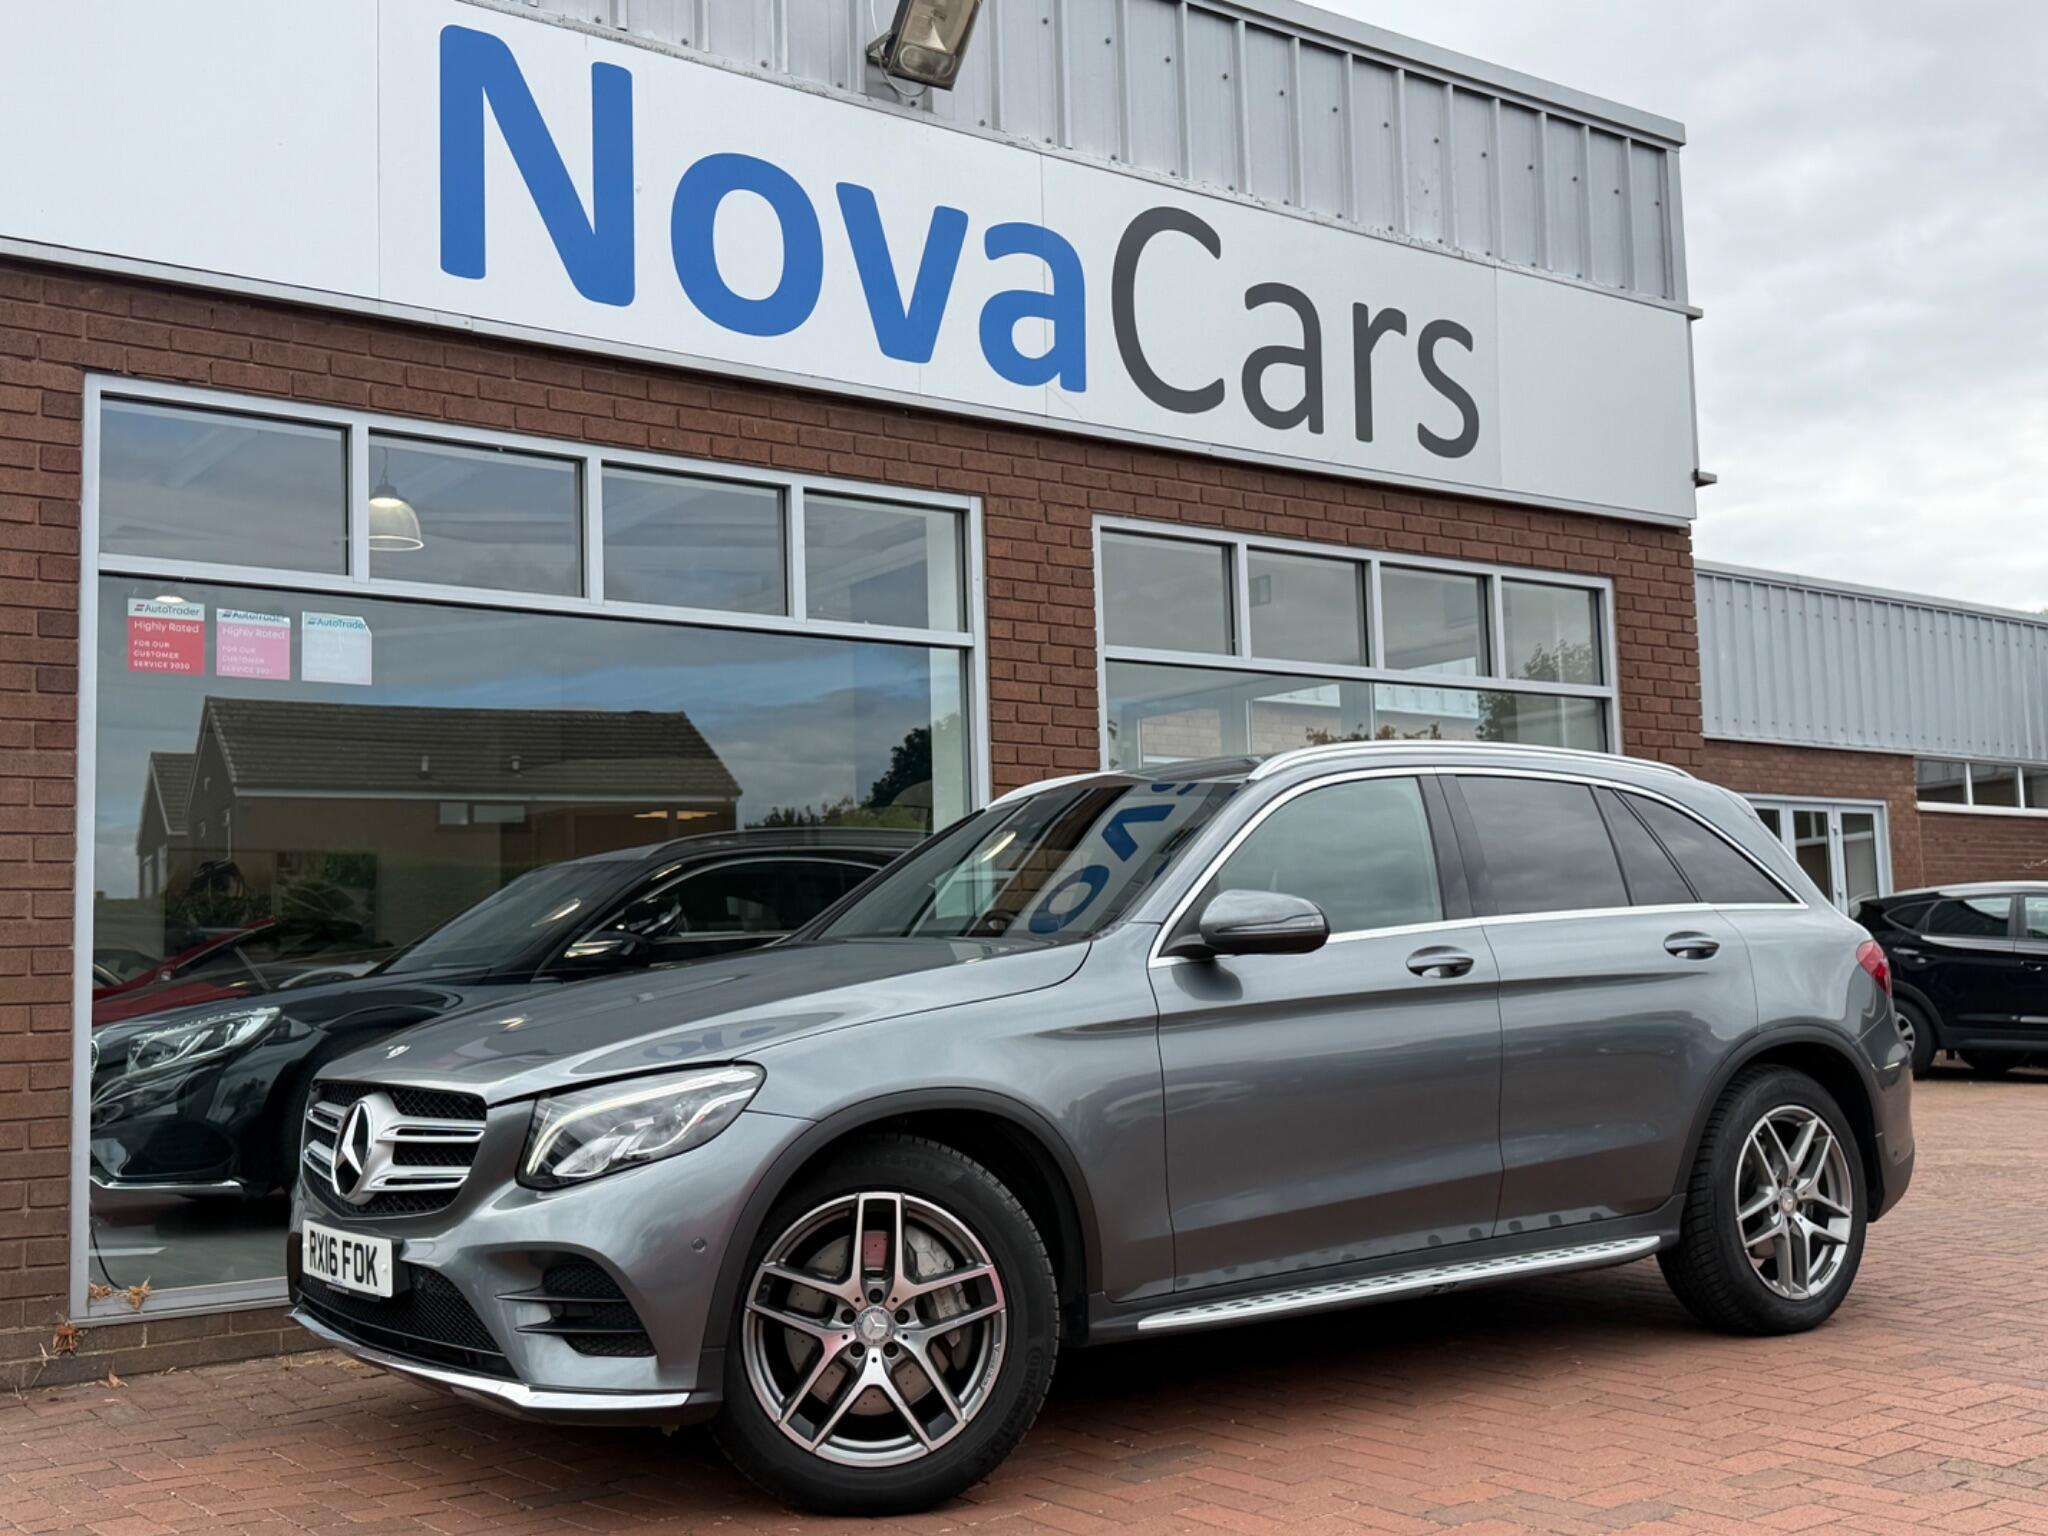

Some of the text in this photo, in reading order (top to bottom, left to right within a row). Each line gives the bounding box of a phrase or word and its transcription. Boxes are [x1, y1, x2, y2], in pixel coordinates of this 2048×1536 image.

[440, 25, 1480, 458] NovaCars
[145, 603, 200, 616] AutoTrader
[134, 620, 200, 634] Highly Rated
[222, 625, 285, 640] Highly Rated
[133, 639, 171, 648] FOR OUR
[133, 650, 180, 660] CUSTOMER
[133, 660, 169, 669] SERVICE
[309, 1229, 378, 1288] RX16 FOK
